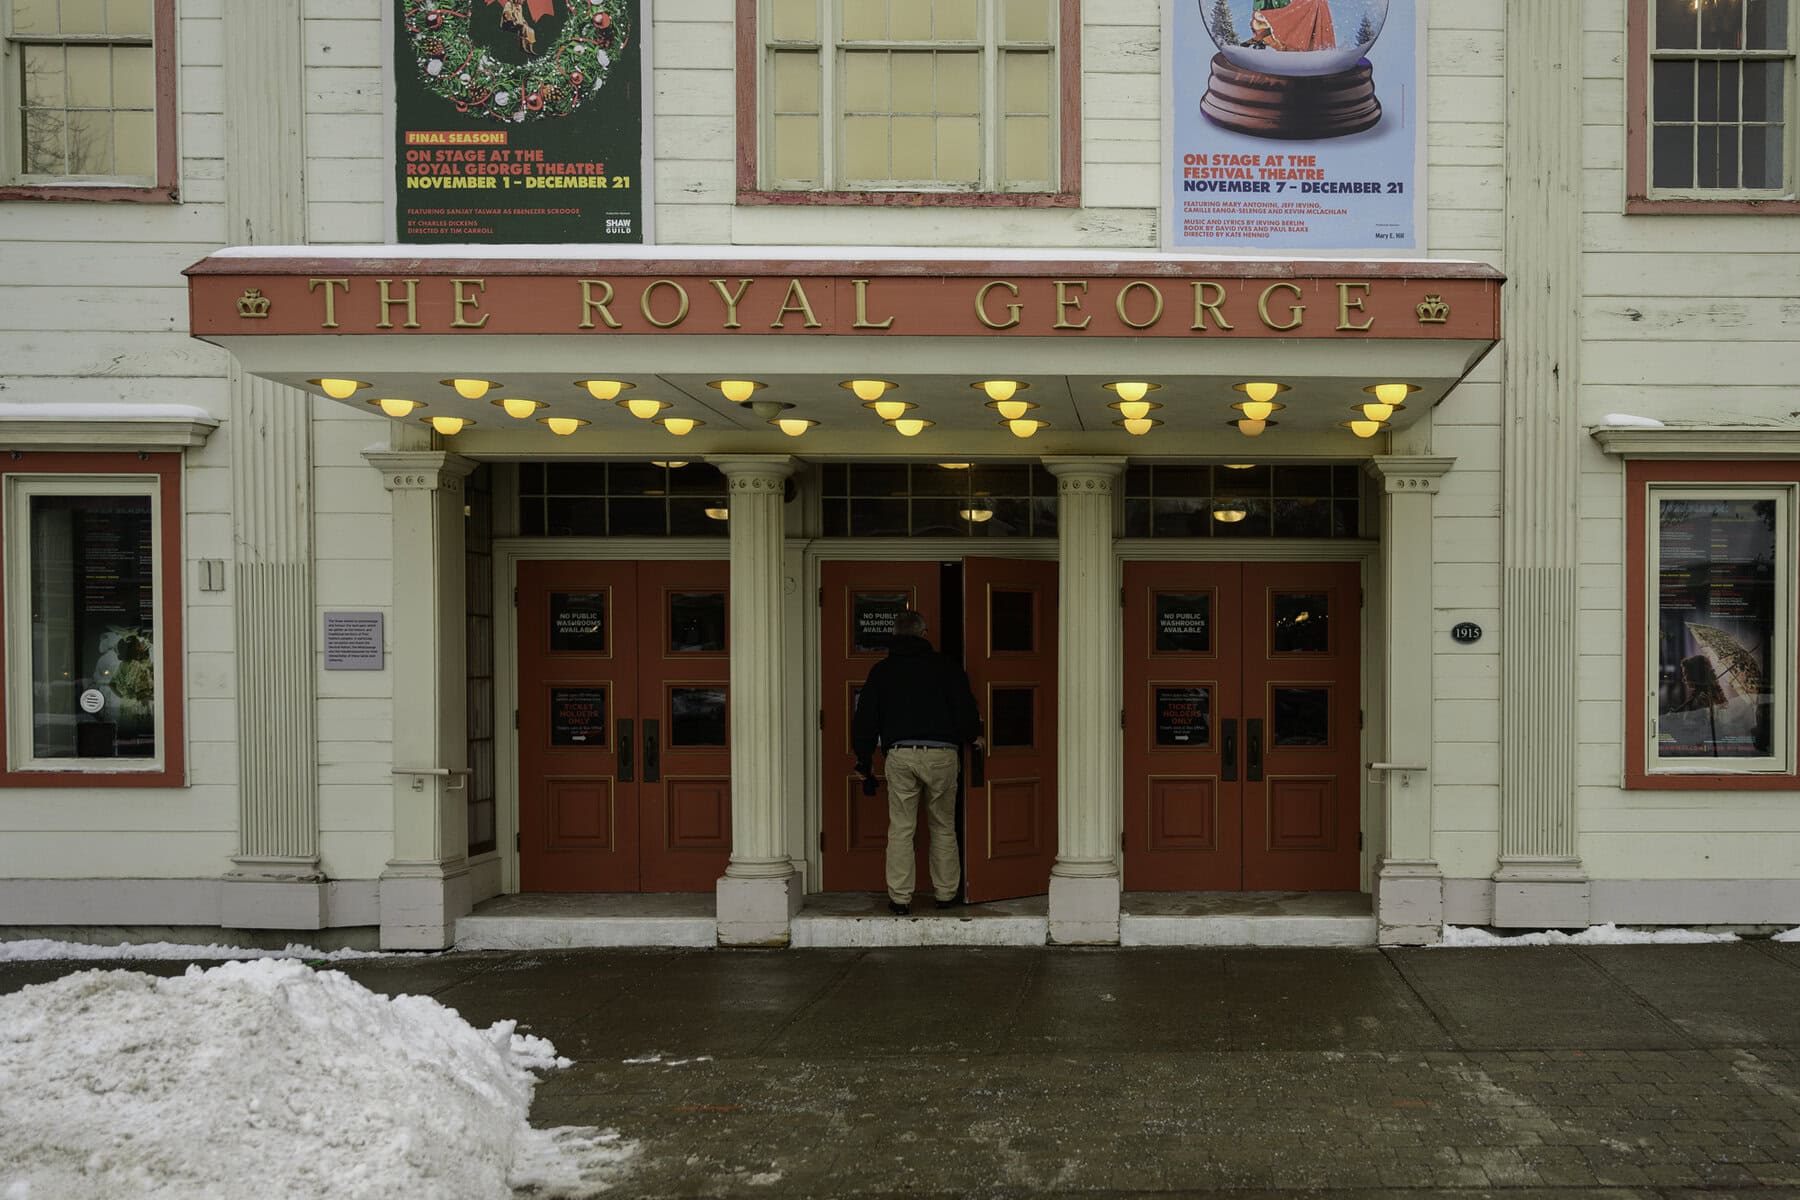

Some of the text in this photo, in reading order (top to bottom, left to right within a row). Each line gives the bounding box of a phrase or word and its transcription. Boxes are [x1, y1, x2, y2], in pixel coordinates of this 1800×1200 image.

[409, 133, 505, 143] FINAL SEASON!
[406, 149, 544, 162] ON STAGE AT THE
[1183, 153, 1316, 167] ON STAGE AT THE
[406, 163, 604, 175] ROYAL GEORGE THEATRE
[1183, 167, 1325, 180] FESTIVAL THEATRE
[406, 176, 497, 189] NOVEMBER
[502, 176, 510, 189] 1
[525, 176, 608, 189] DECEMBER
[611, 176, 630, 189] 21
[1183, 180, 1271, 193] NOVEMBER
[1275, 181, 1287, 193] 7
[1301, 182, 1382, 194] DECEMBER
[1386, 182, 1403, 194] 21
[605, 219, 631, 227] SHAW
[1375, 232, 1389, 240] Mary
[308, 277, 1377, 332] THE ROYAL GEORGE
[863, 612, 874, 620] NO
[1456, 628, 1480, 638] 1915
